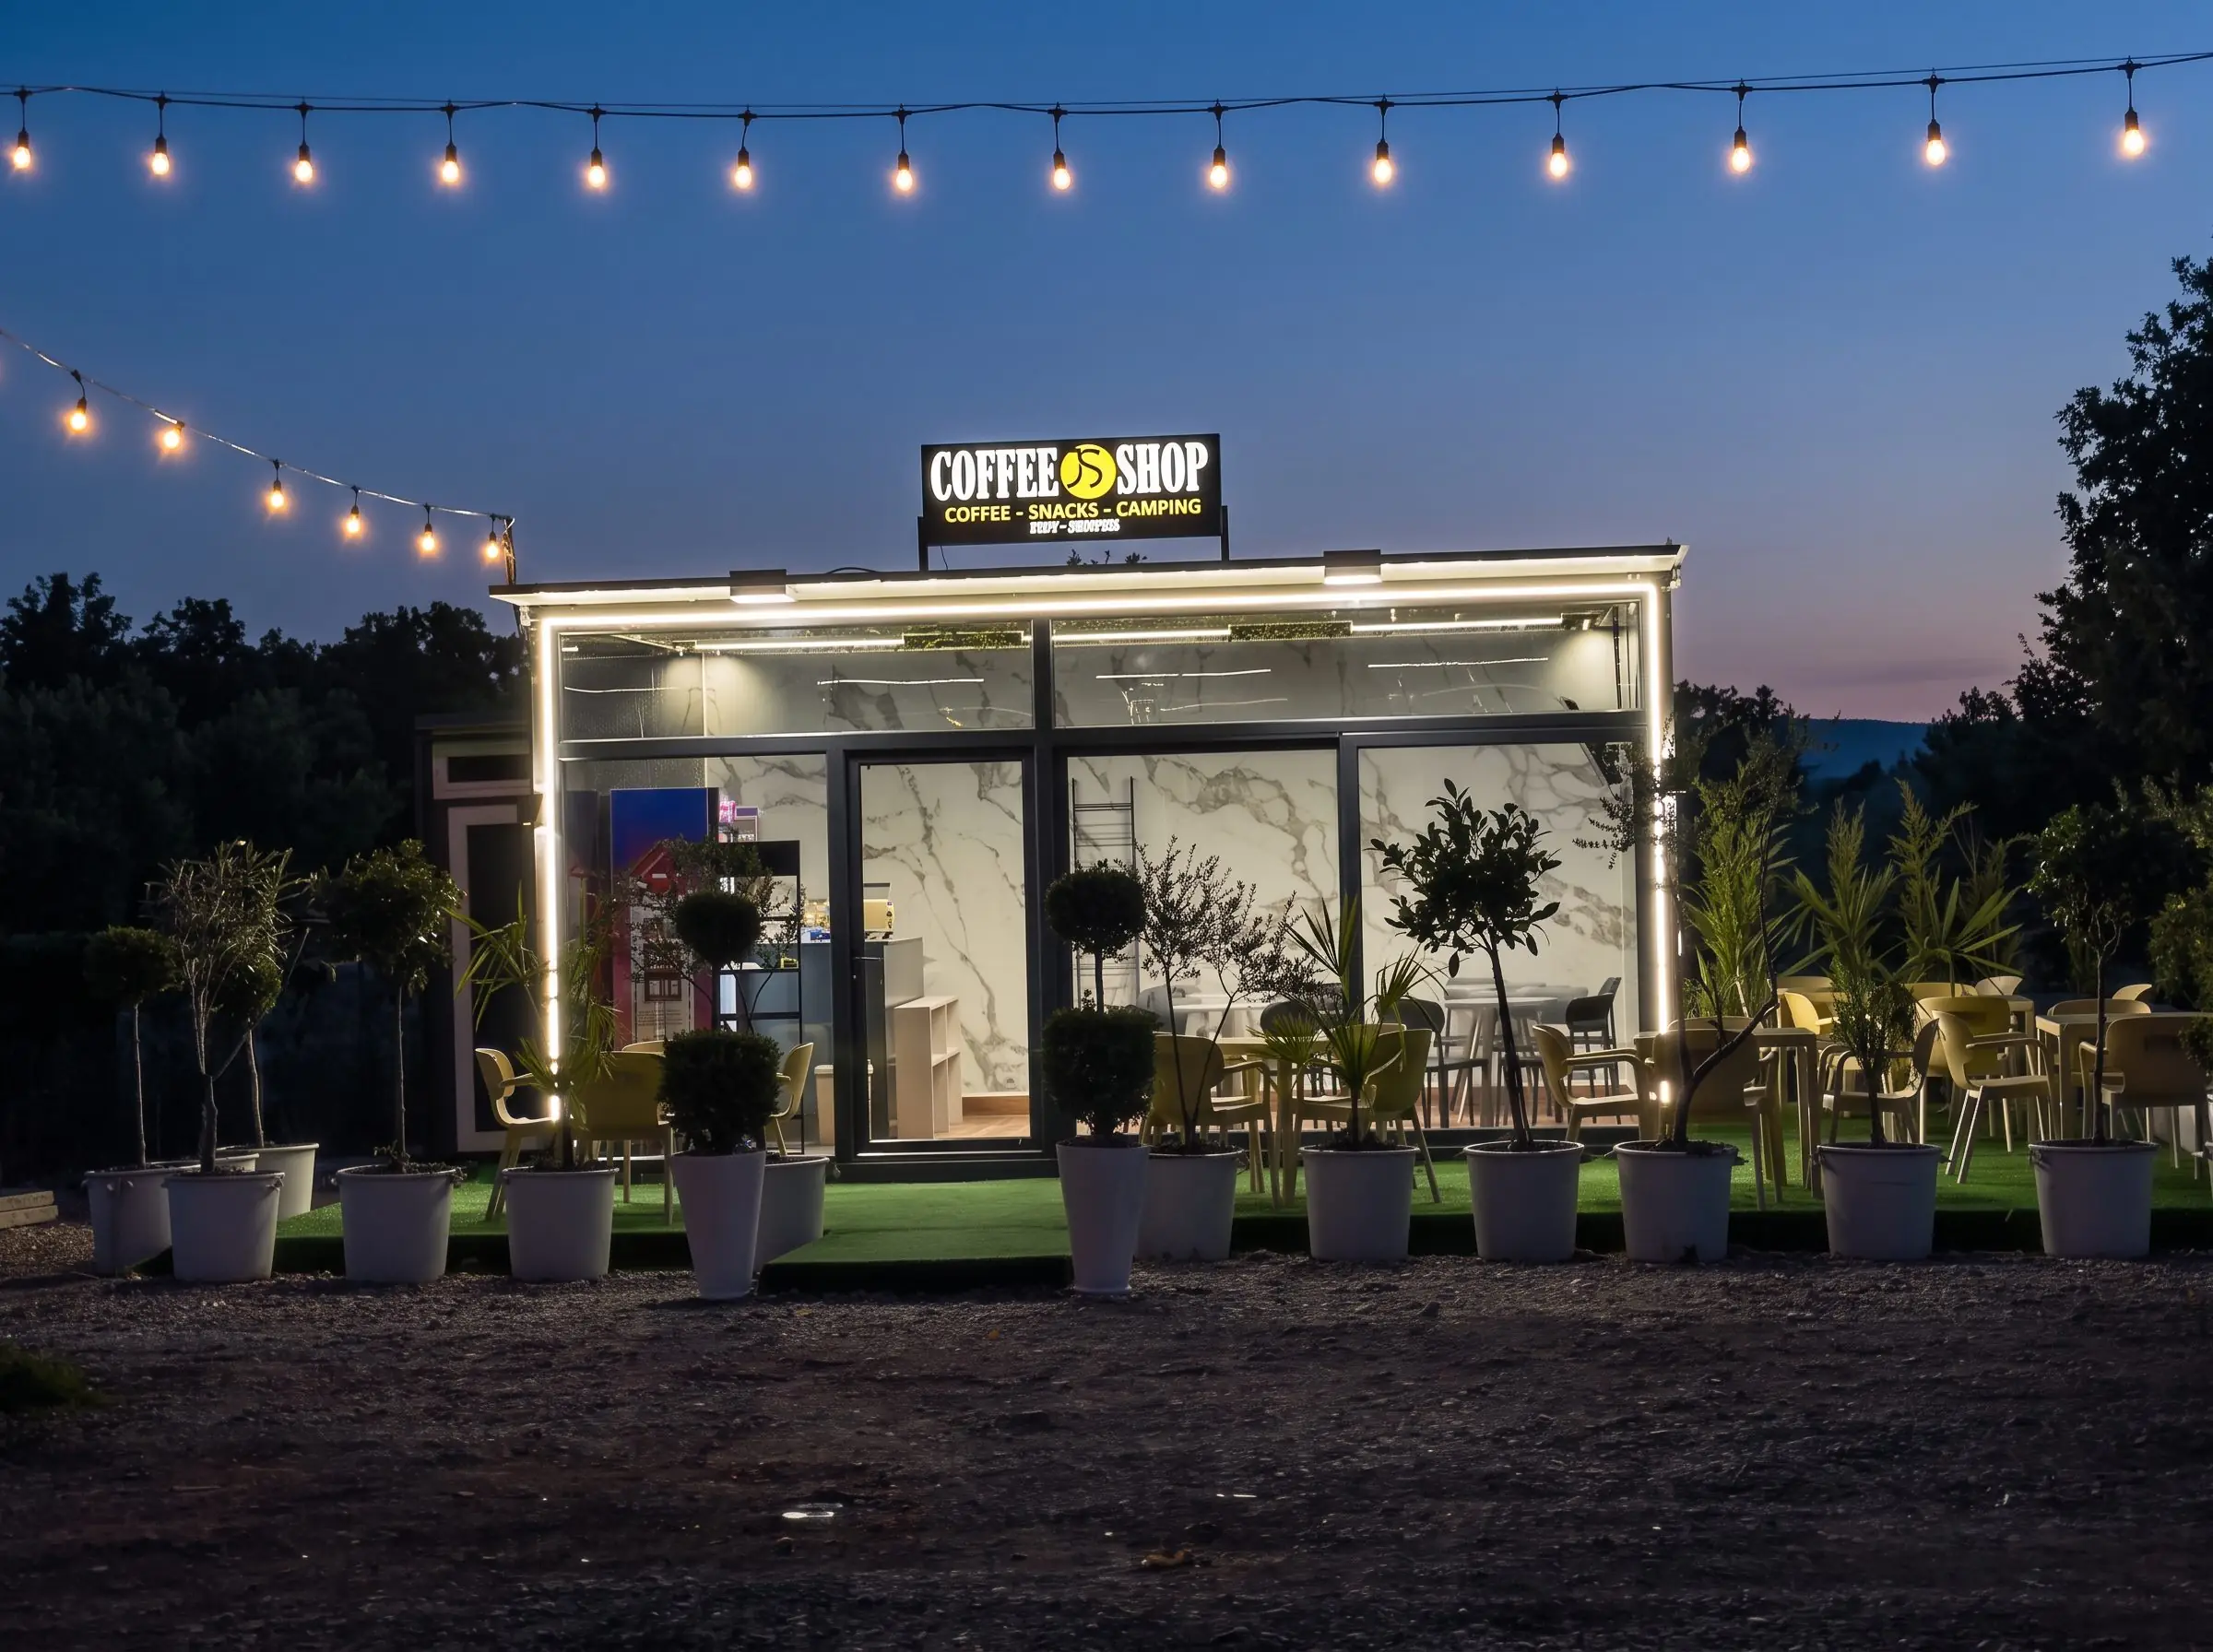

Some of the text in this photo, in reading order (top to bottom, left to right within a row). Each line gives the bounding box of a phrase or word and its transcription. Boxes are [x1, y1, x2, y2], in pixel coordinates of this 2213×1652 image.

[930, 447, 1059, 502] COFFEE
[1116, 442, 1209, 495] SHOP
[945, 505, 1011, 523] COFFEE
[1028, 502, 1098, 520] SNACKS
[1116, 498, 1201, 516] CAMPING
